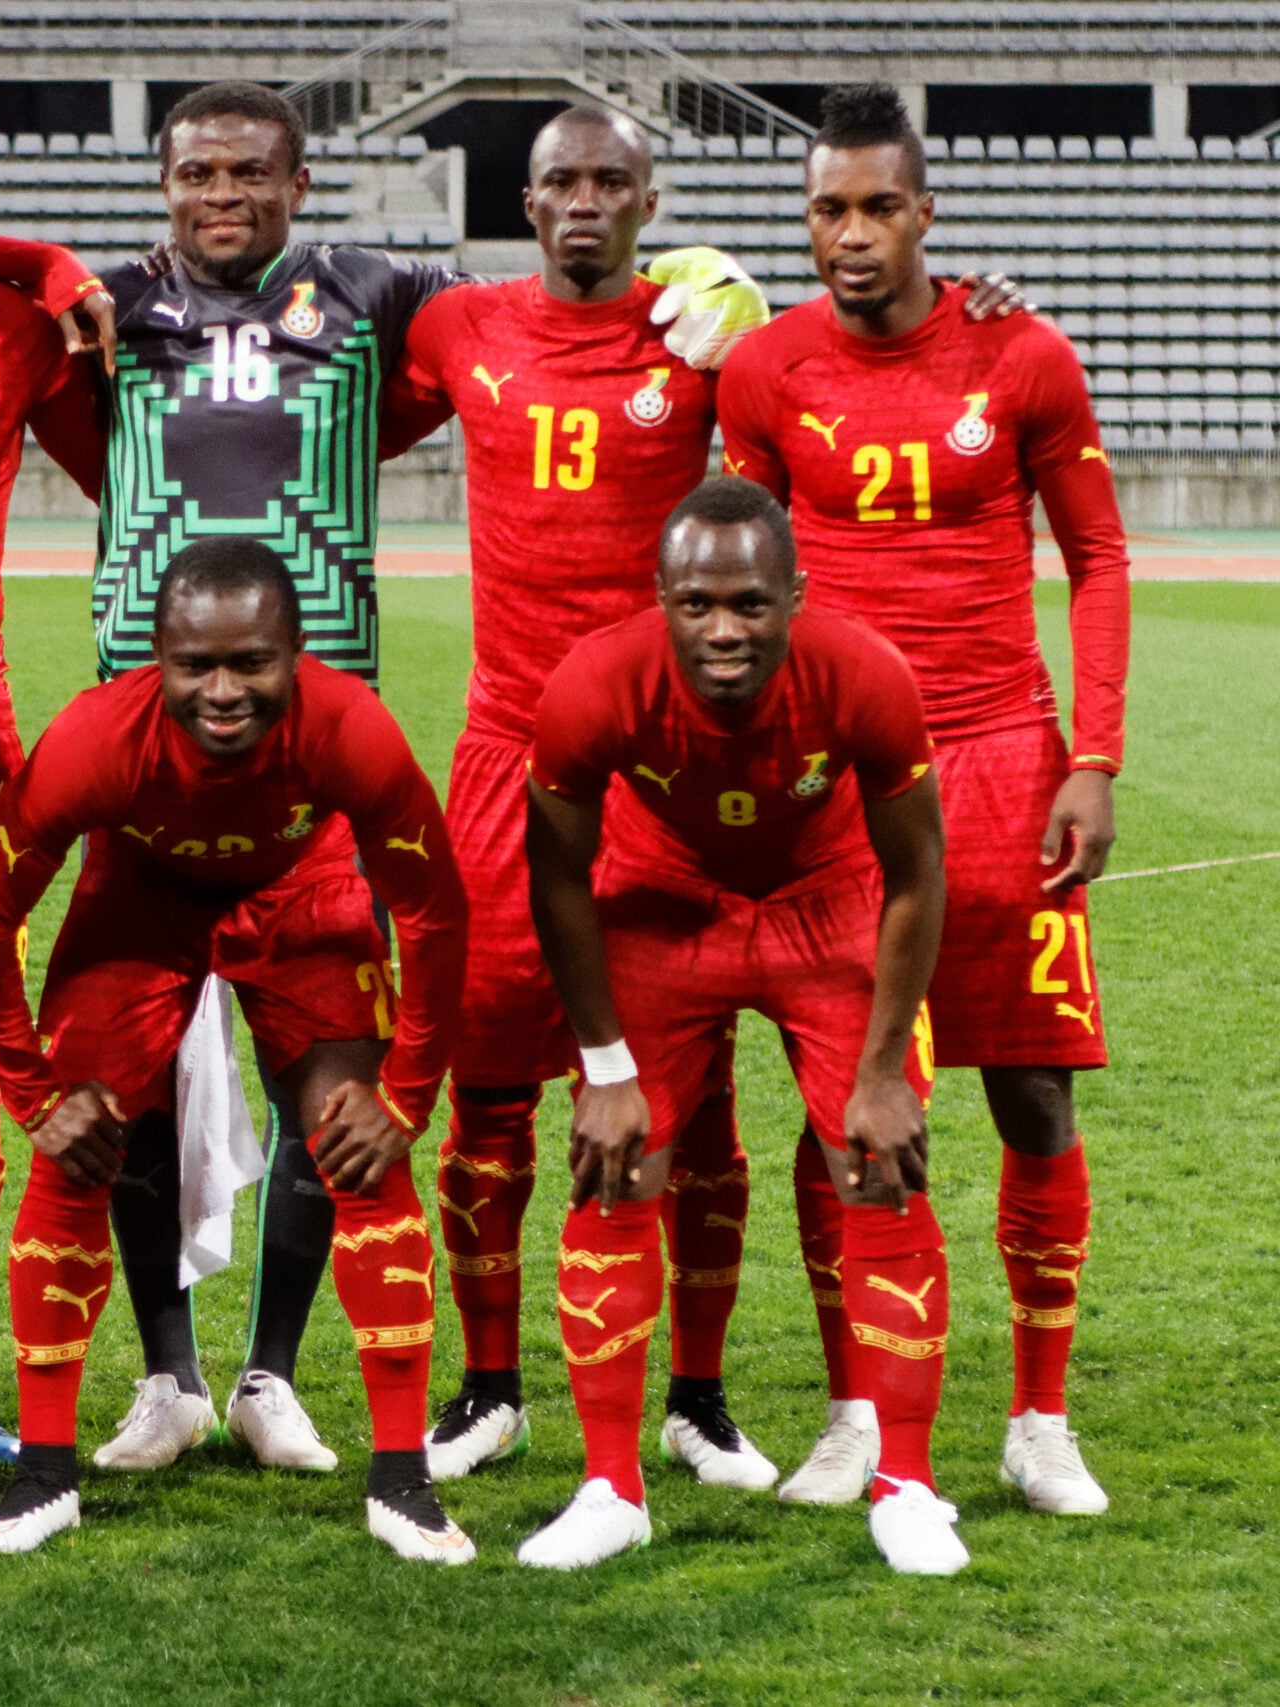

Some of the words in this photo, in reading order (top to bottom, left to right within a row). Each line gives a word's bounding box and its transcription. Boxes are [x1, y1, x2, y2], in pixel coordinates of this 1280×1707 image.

[203, 325, 273, 401] 16
[527, 405, 599, 491] 13
[853, 443, 931, 521] 21
[719, 791, 756, 826] 8
[1031, 911, 1095, 995] 21
